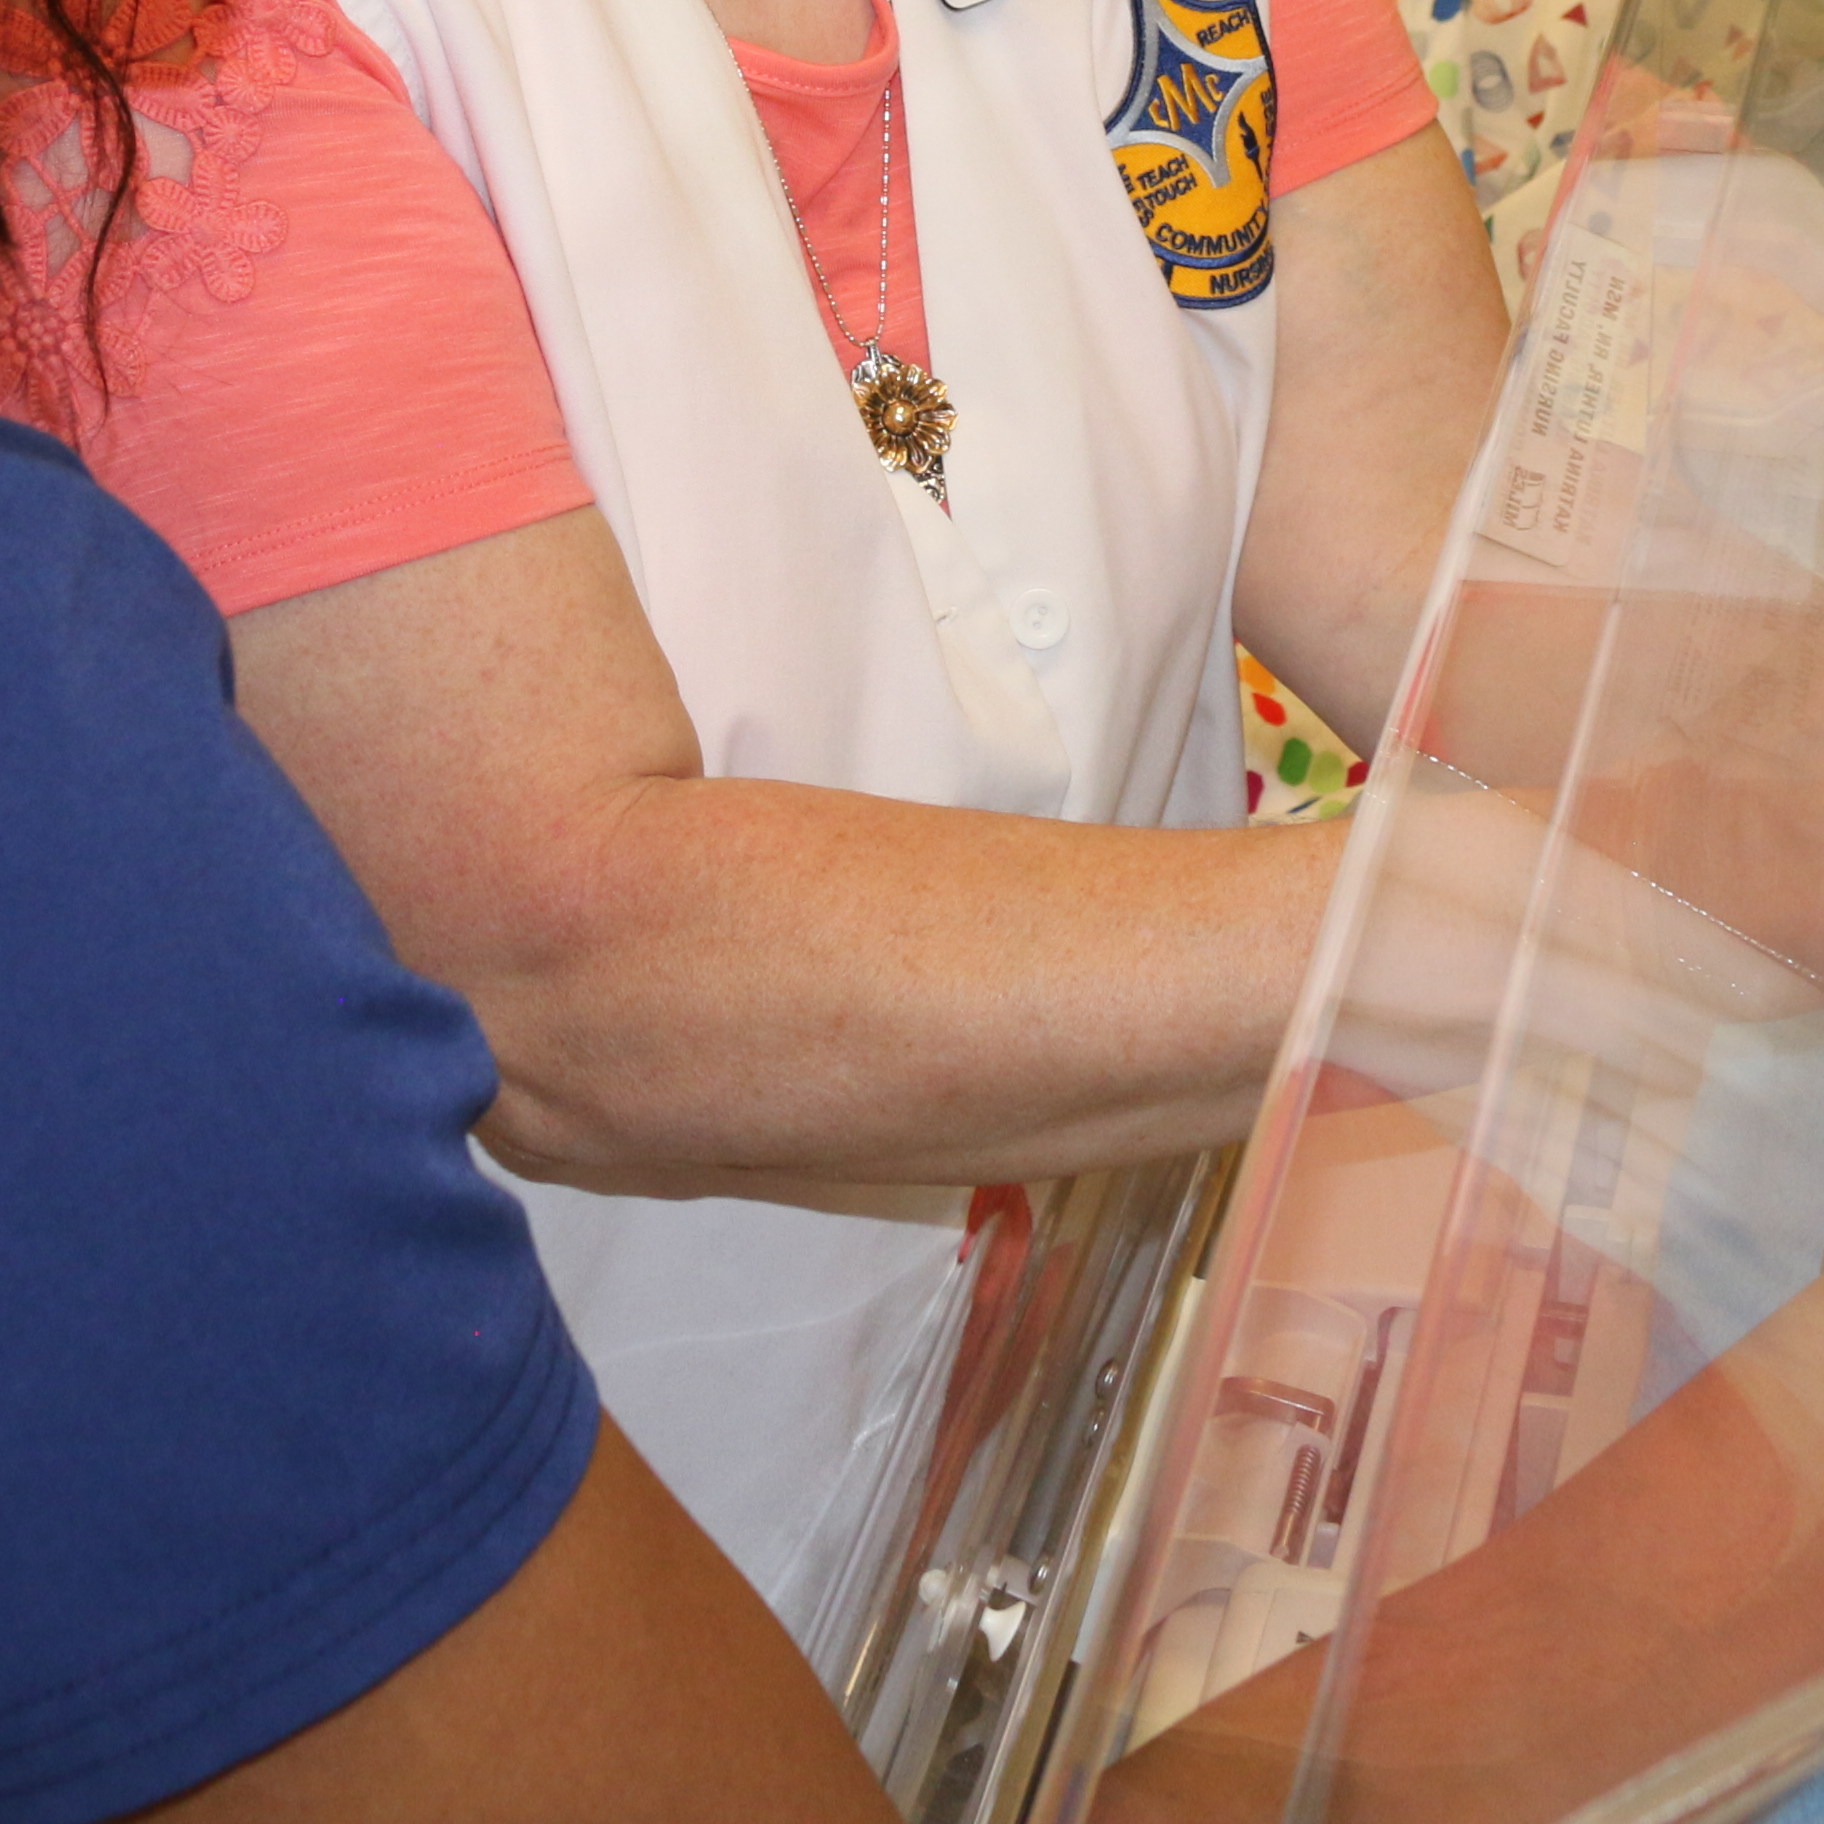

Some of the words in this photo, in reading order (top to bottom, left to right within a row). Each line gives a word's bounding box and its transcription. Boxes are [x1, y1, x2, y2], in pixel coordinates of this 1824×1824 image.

[1196, 10, 1252, 47] REACH
[1136, 153, 1189, 191] TEACH
[1143, 172, 1198, 210] TOUCH
[1156, 201, 1270, 256] COMMUNITY
